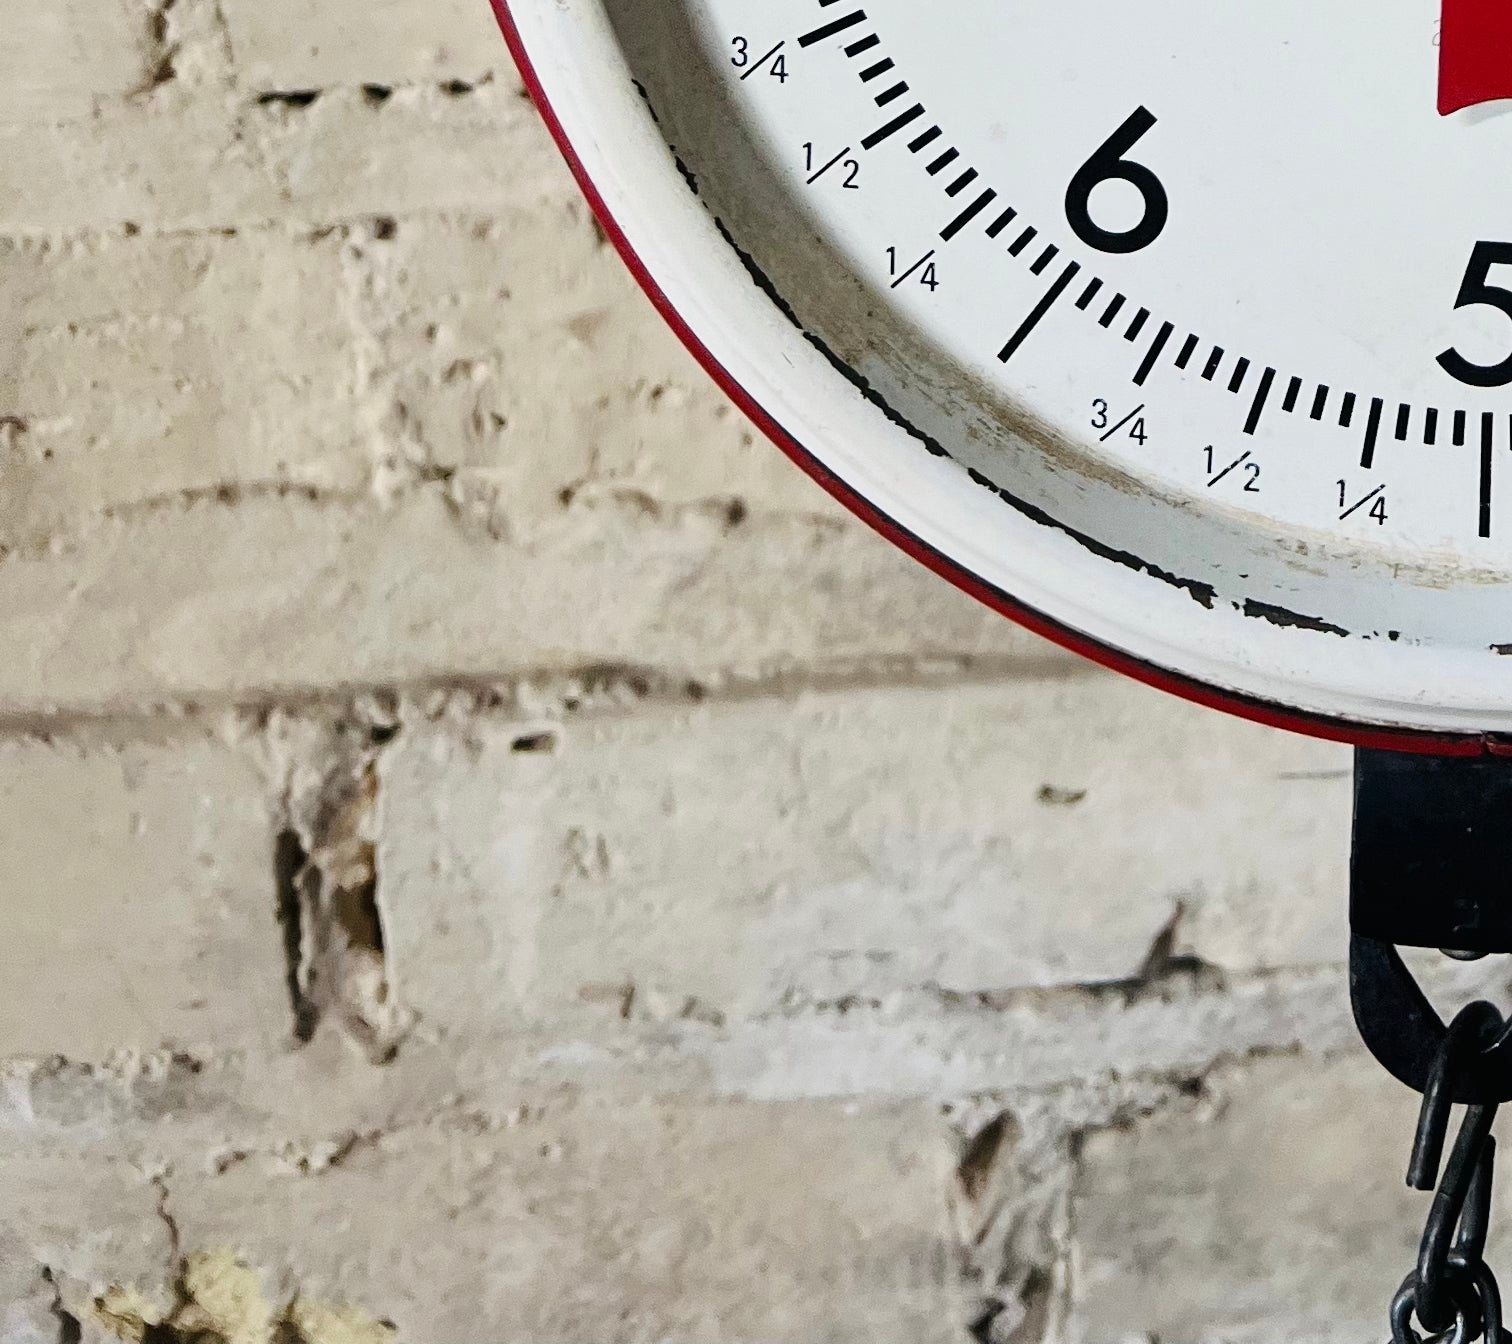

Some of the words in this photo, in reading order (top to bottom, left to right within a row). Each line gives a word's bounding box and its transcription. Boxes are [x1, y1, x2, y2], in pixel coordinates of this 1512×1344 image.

[731, 36, 789, 83] 3/4
[803, 142, 859, 189] 1/2
[1065, 105, 1168, 254] 6
[886, 247, 939, 292] 1/4
[1090, 399, 1148, 446] 3/4
[1204, 445, 1260, 492] 1/2
[1337, 479, 1388, 525] 1/4
